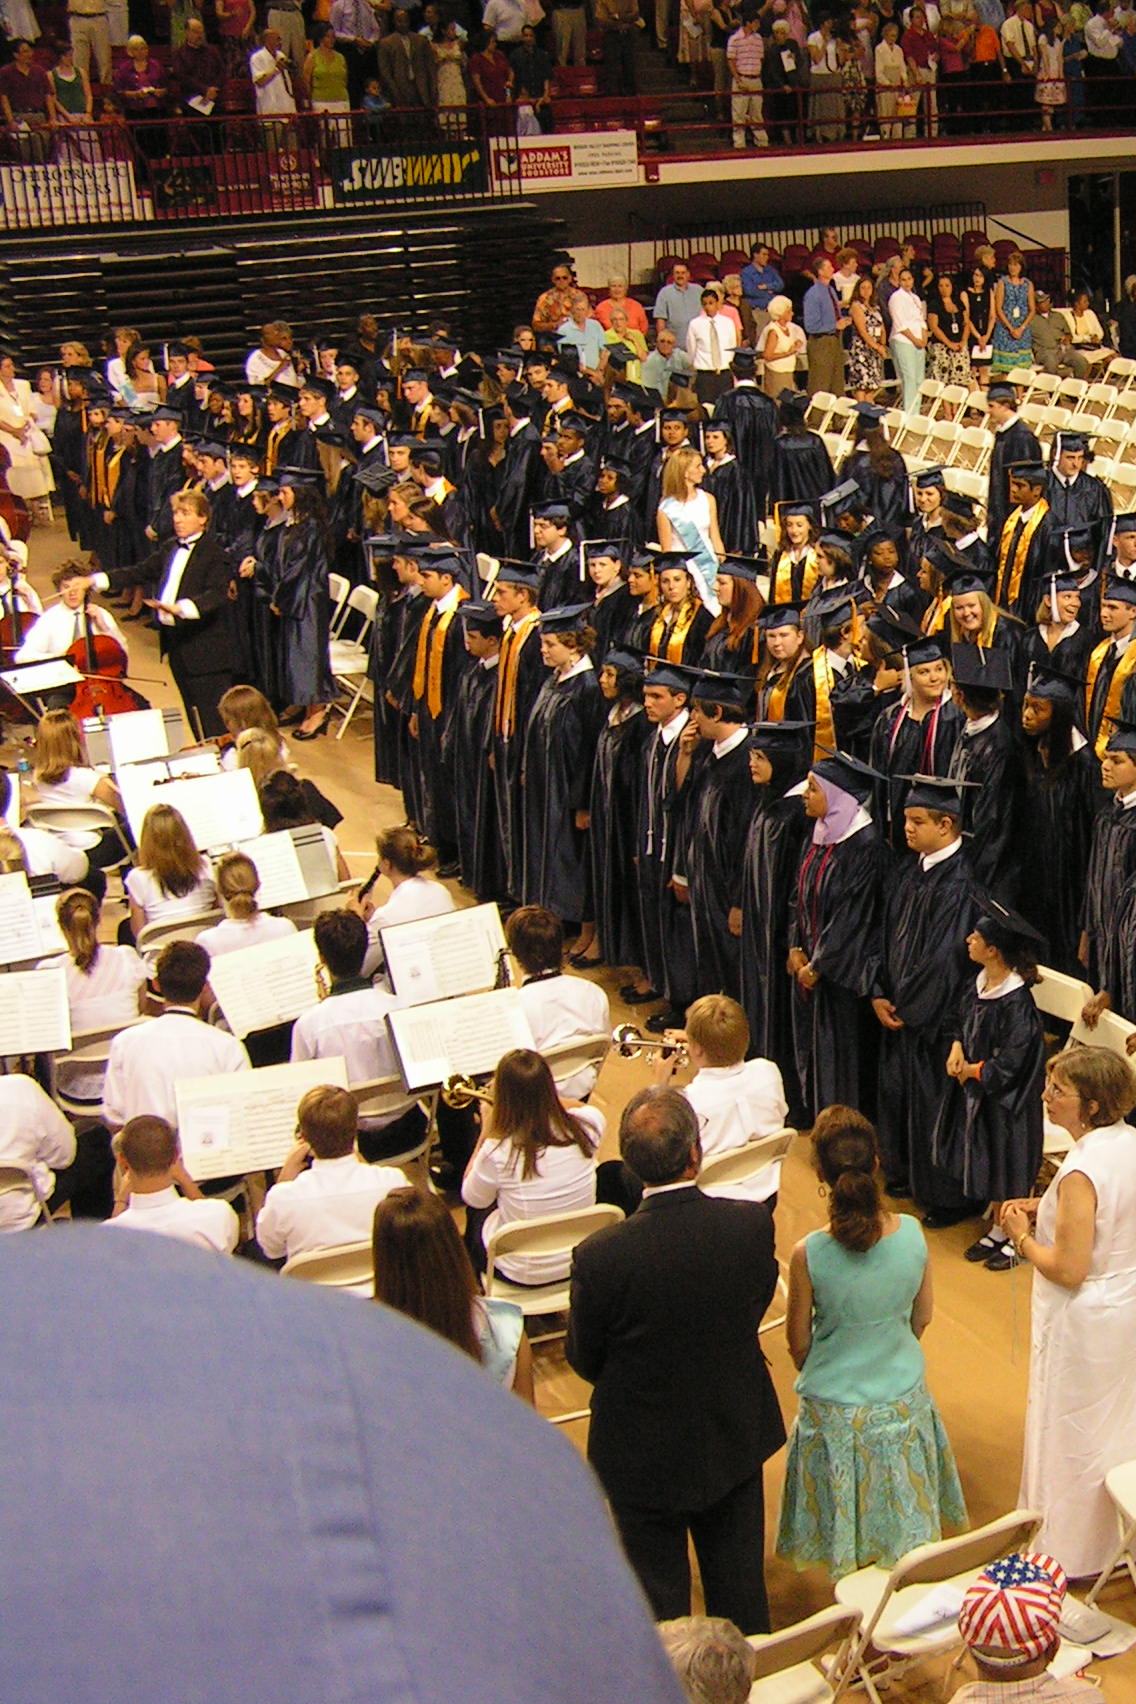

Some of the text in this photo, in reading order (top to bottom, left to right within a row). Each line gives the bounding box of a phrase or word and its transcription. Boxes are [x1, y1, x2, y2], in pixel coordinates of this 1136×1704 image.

[521, 150, 569, 163] ADDAM'S
[341, 151, 480, 192] SUBWAY
[521, 160, 570, 171] UNIVERSITY
